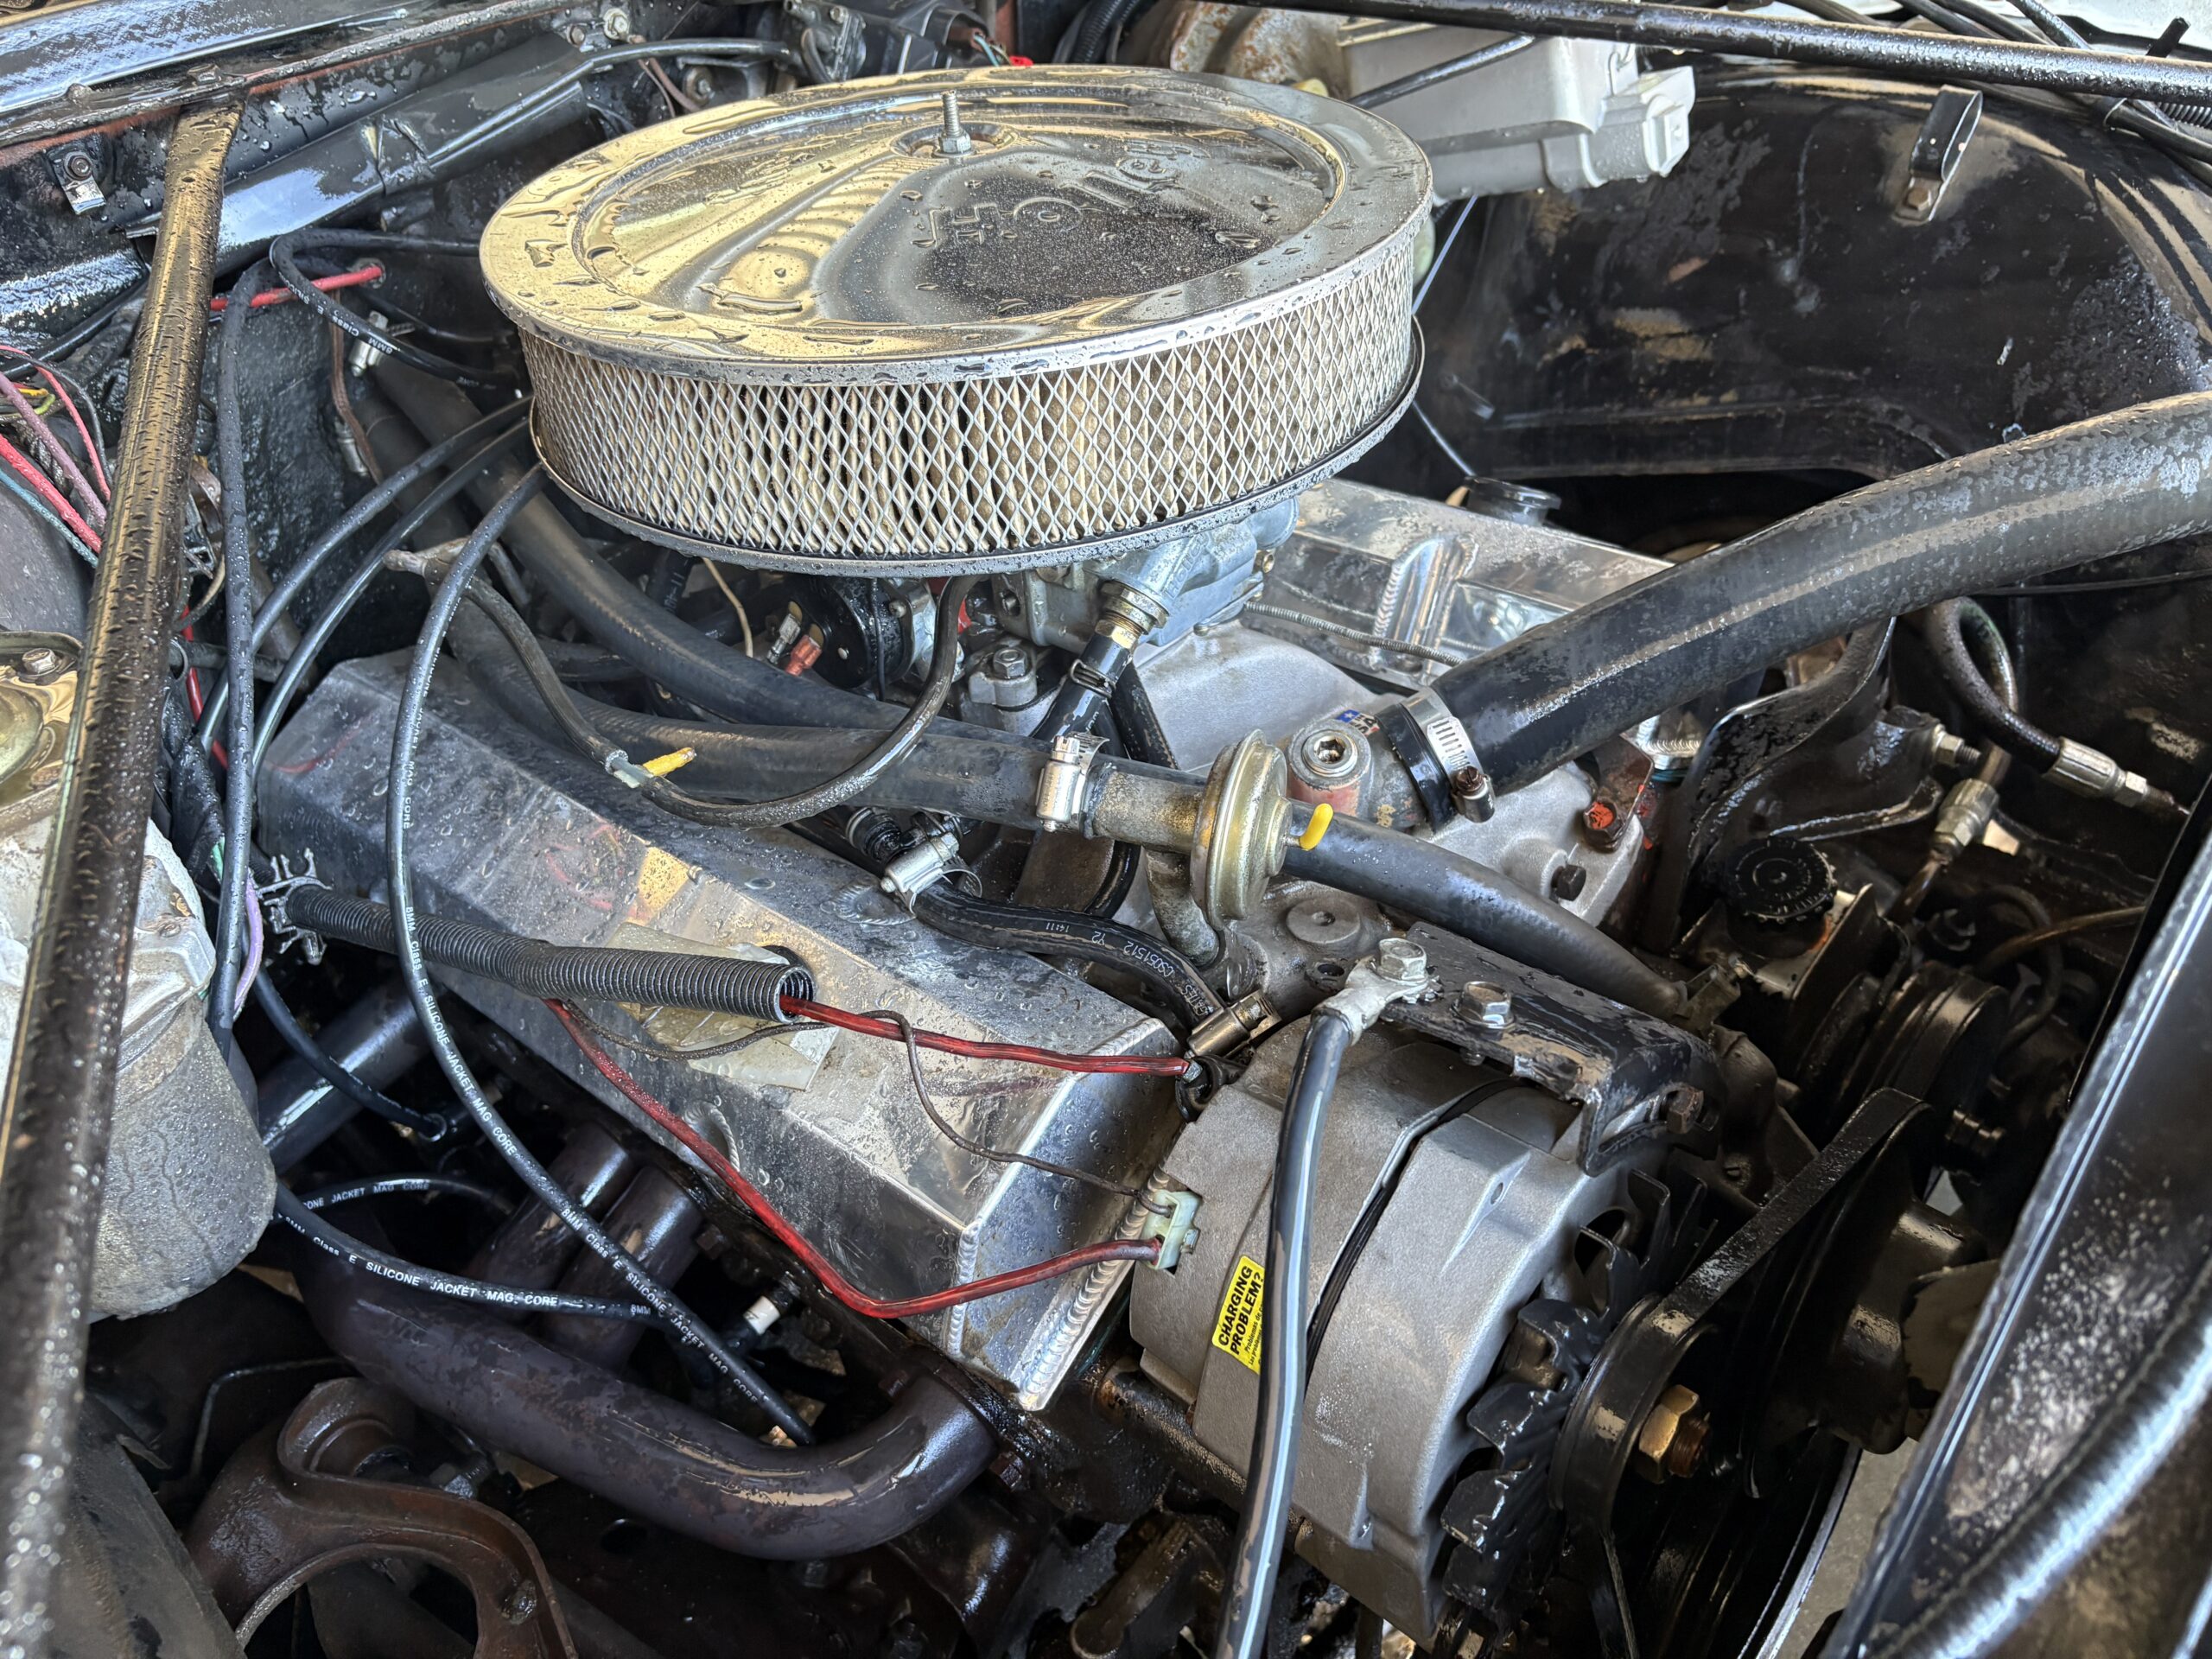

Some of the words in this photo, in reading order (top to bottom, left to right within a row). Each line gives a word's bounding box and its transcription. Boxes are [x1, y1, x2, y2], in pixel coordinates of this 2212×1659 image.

[332, 315, 359, 337] Class
[368, 338, 393, 354] 8MM
[403, 797, 412, 830] CORE
[405, 906, 416, 932] 8MM
[1091, 931, 1106, 946] Y2
[410, 941, 423, 972] Class
[418, 977, 429, 987] E
[423, 995, 450, 1046] SILICONE
[447, 1052, 476, 1094] JACKET
[472, 1097, 493, 1122] MAG
[493, 1126, 518, 1156] CORE
[331, 1187, 365, 1204] JACKET
[562, 1208, 583, 1231] 8MM
[586, 1233, 609, 1258] Class
[313, 1236, 340, 1256] Class
[348, 1255, 358, 1264] E
[365, 1262, 422, 1287] SILICONE
[430, 1281, 477, 1298] JACKET
[524, 1294, 559, 1307] CORE
[613, 1258, 623, 1271] E
[626, 1273, 666, 1312] SILICONE
[1219, 1266, 1252, 1346] CHARGING
[1230, 1272, 1264, 1355] PROBLEM?
[671, 1316, 705, 1348] JACKET
[1245, 1320, 1258, 1353] Problemas
[709, 1353, 728, 1374] MAG
